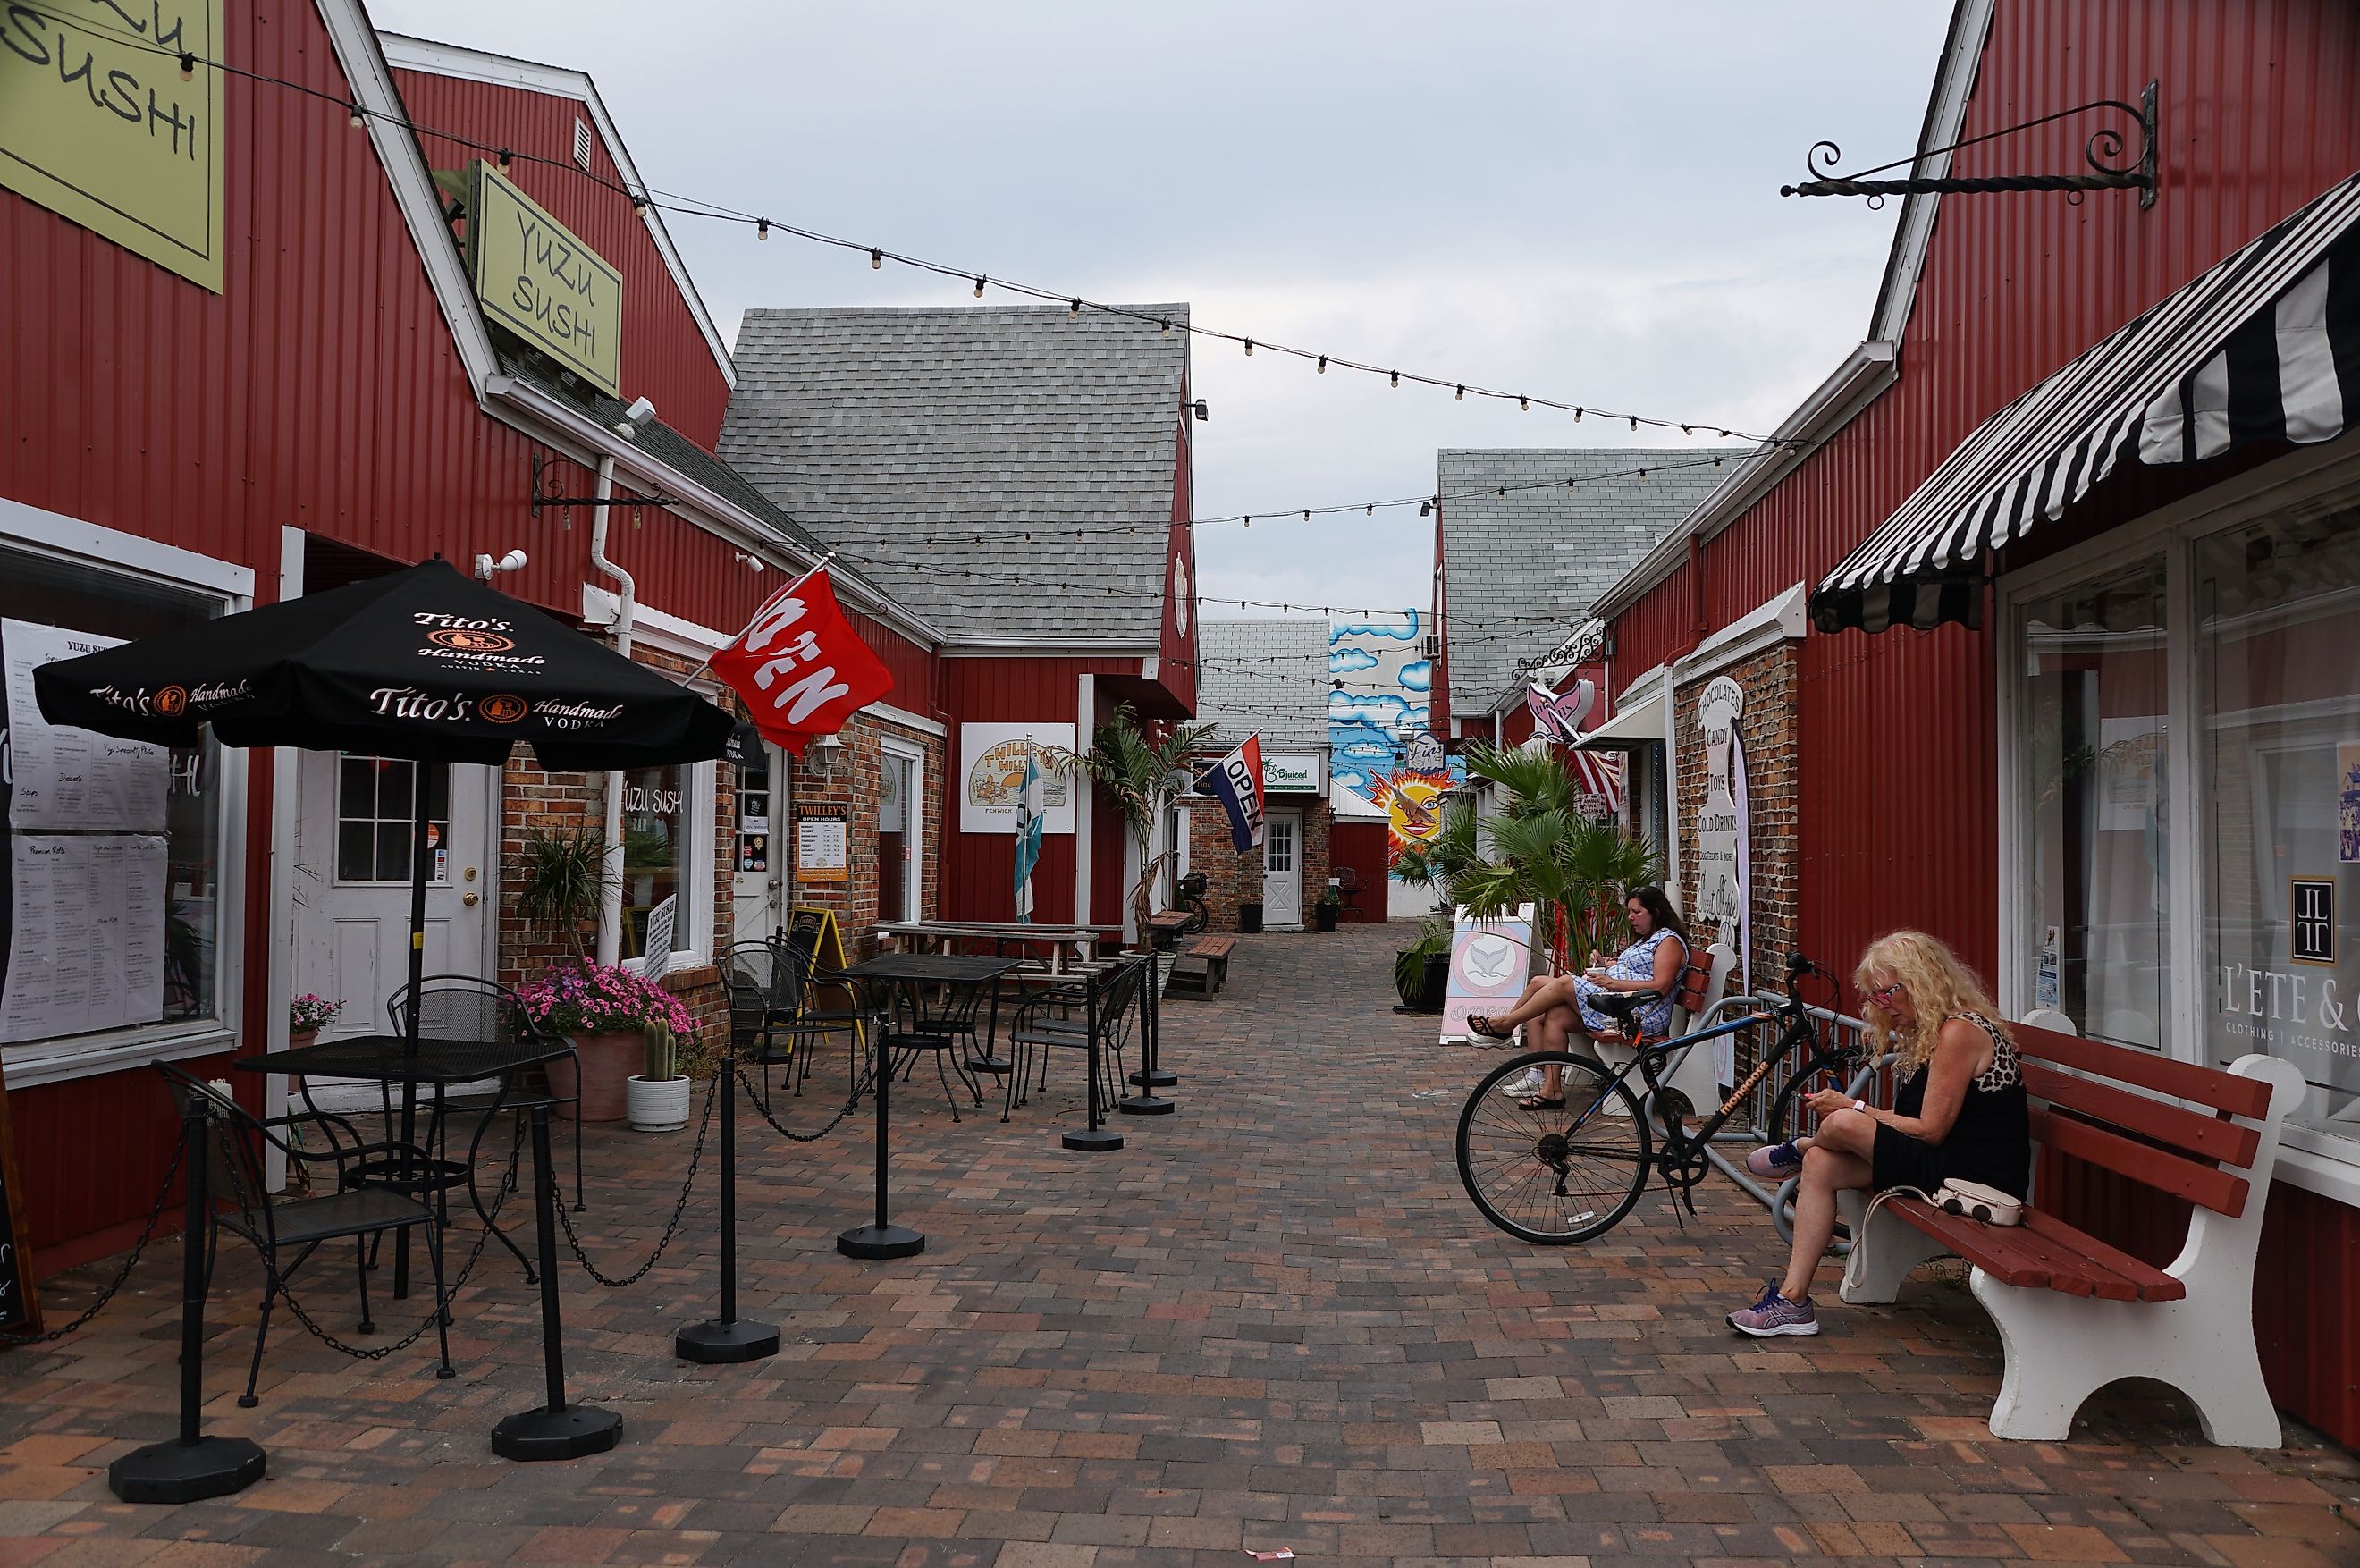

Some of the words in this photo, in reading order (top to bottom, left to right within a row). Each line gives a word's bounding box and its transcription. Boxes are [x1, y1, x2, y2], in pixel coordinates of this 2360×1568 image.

[0, 5, 196, 162] SUSHI
[516, 209, 594, 307] YUZU
[512, 275, 596, 359] SUSHI
[67, 640, 91, 653] YUZU
[417, 648, 546, 665] Handmade
[439, 663, 481, 671] AUSTIN
[455, 659, 521, 670] VODKA
[533, 698, 625, 721] Handmade
[1698, 684, 1740, 723] CHOCOLATES
[544, 716, 605, 730] VODKA
[1707, 727, 1729, 747] CANDY
[1277, 768, 1308, 780] Bjuiced
[1709, 773, 1725, 792] TOYS
[653, 789, 684, 814] SUSHI
[1227, 760, 1264, 832] OPEN
[798, 805, 847, 816] TWILLEY'S
[1698, 814, 1714, 833] COLD
[2224, 962, 2307, 1024] L'ETE
[2319, 978, 2349, 1032] &
[2225, 1021, 2274, 1041] CLOTHING
[1720, 1060, 1770, 1116] mongoose
